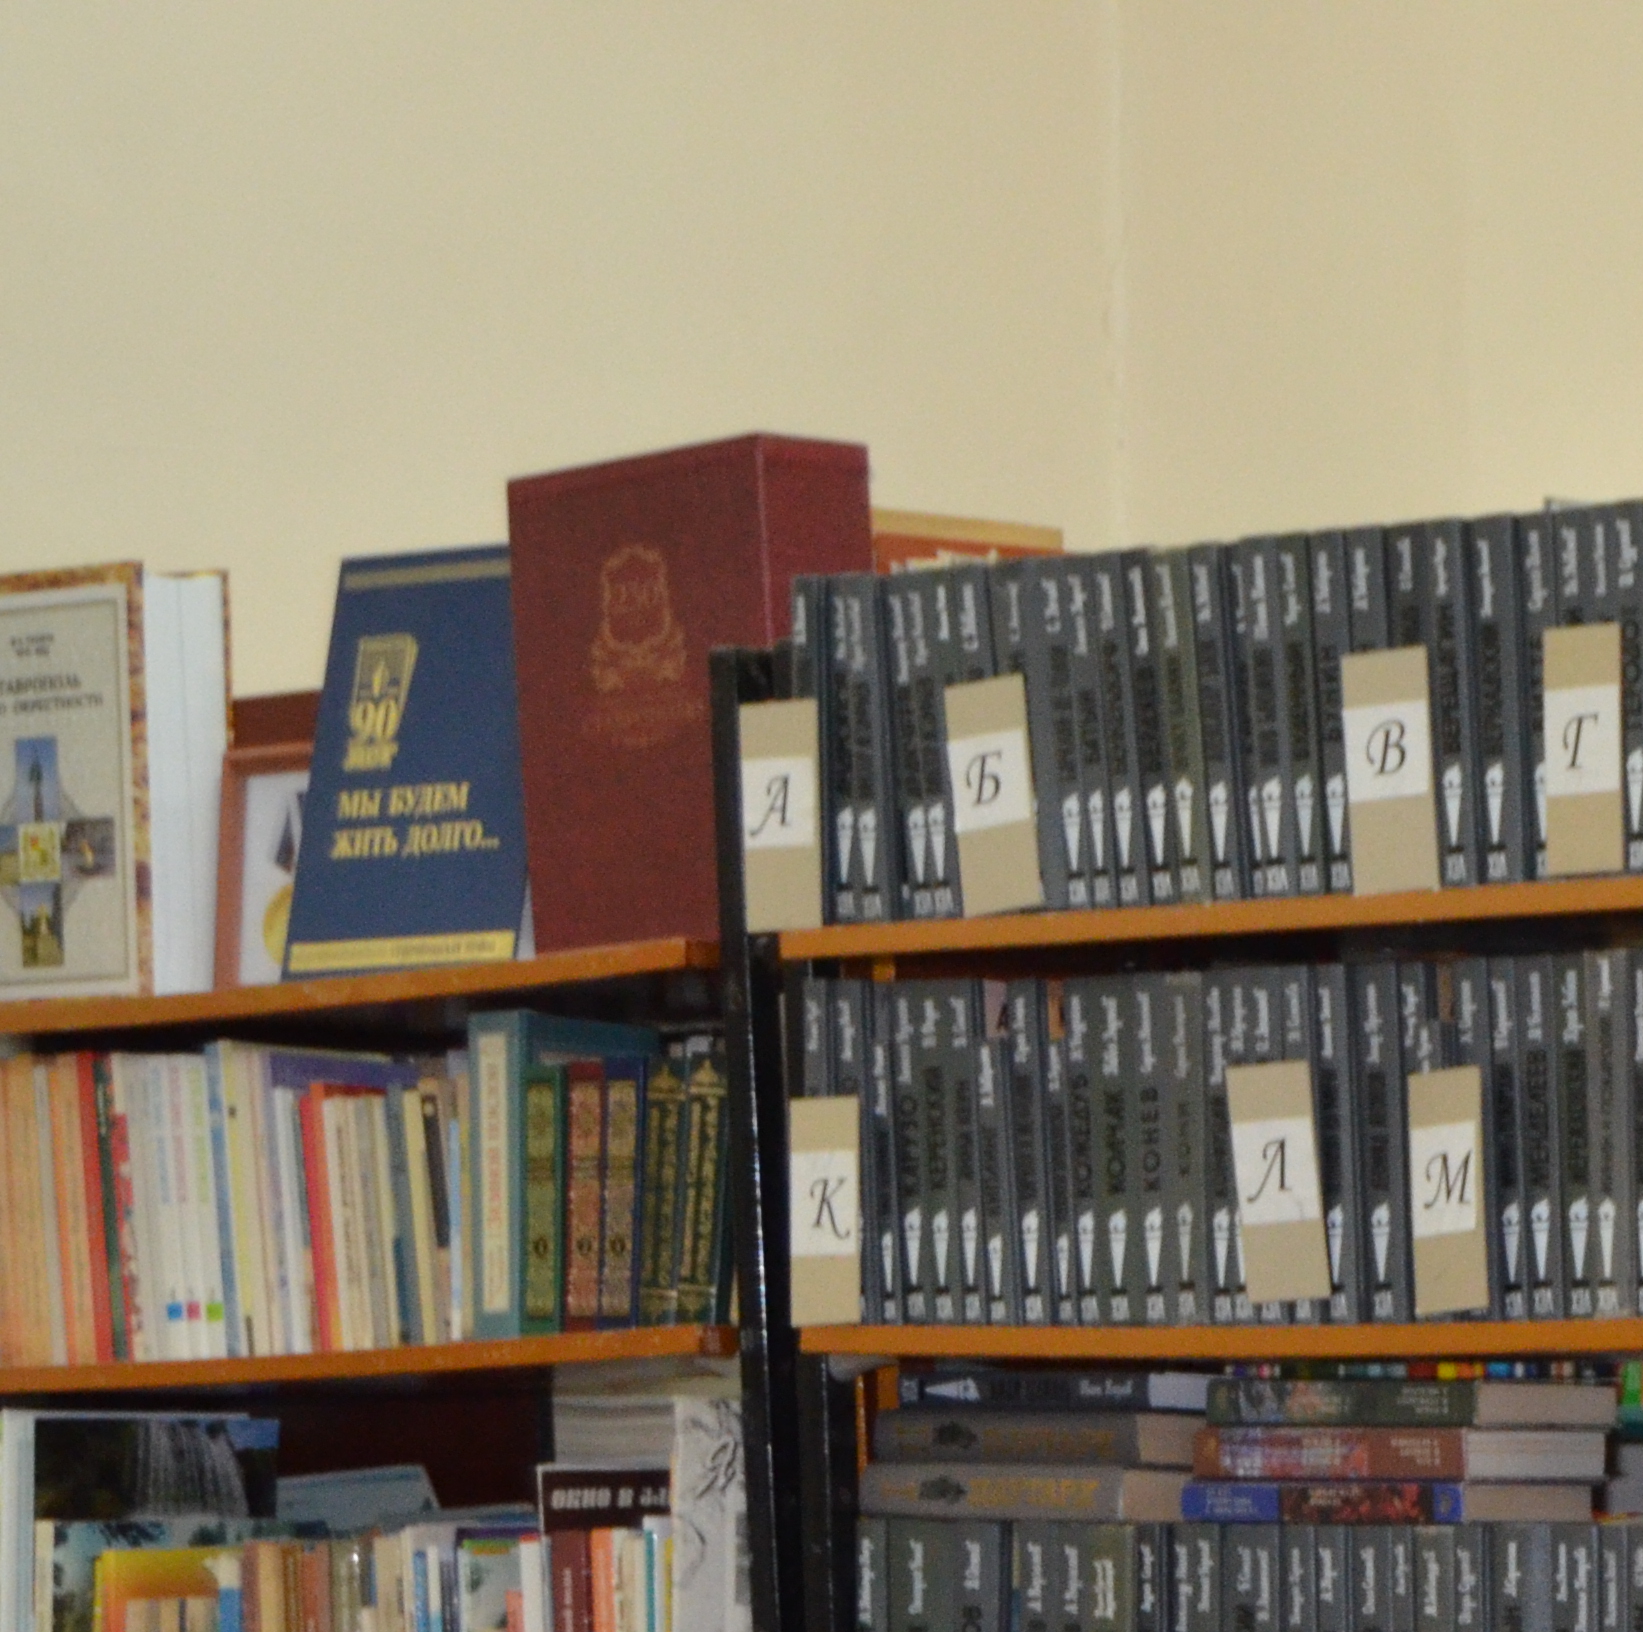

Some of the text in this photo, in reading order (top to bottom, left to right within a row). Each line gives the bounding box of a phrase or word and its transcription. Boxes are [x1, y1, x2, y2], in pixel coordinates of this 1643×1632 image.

[350, 700, 400, 738] 90
[1367, 720, 1408, 775] В
[339, 782, 470, 818] МЫ БУДЕМ
[749, 775, 791, 836] А
[966, 751, 1003, 806] Б
[332, 820, 499, 859] ЖИТЬ ДОЛГО...
[1069, 1074, 1093, 1198] КОЖЕДУБ
[1103, 1088, 1127, 1195] КОЛЧАК
[1140, 1086, 1161, 1192] КОНЕВ
[1528, 1050, 1549, 1188] МЕНДЕЛЕЕВ
[1246, 1138, 1294, 1202] Л
[1424, 1150, 1472, 1210] М
[809, 1177, 851, 1239] К
[551, 1487, 612, 1509] ОКНО
